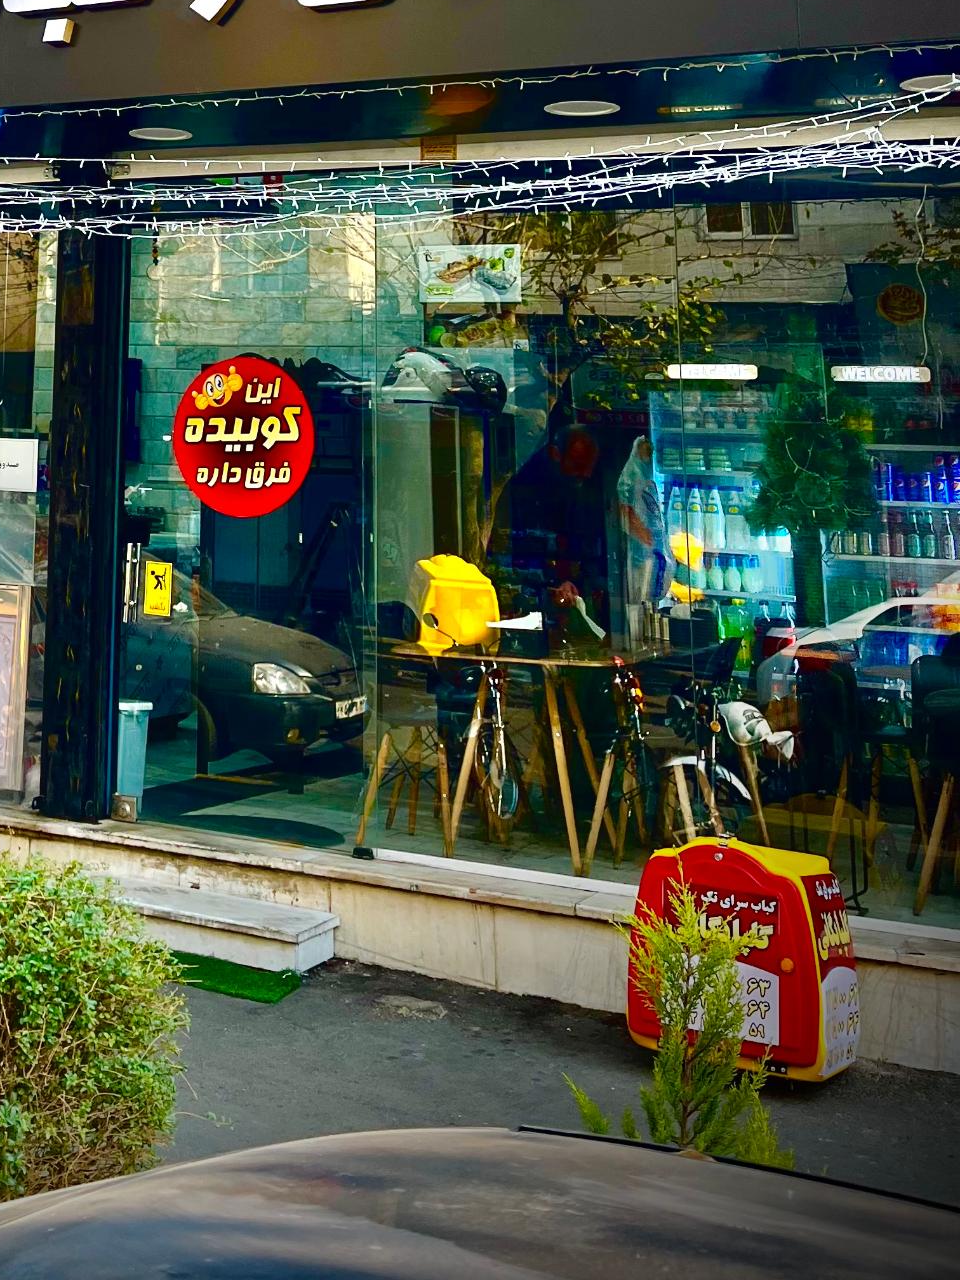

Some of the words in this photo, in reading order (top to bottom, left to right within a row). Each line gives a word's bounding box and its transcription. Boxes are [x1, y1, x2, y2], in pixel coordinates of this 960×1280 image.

[840, 367, 921, 382] WELCOME
[245, 378, 281, 404] این
[185, 407, 301, 452] کوبیده
[196, 462, 242, 487] داره
[245, 462, 291, 489] فرق
[750, 899, 777, 915] کباب
